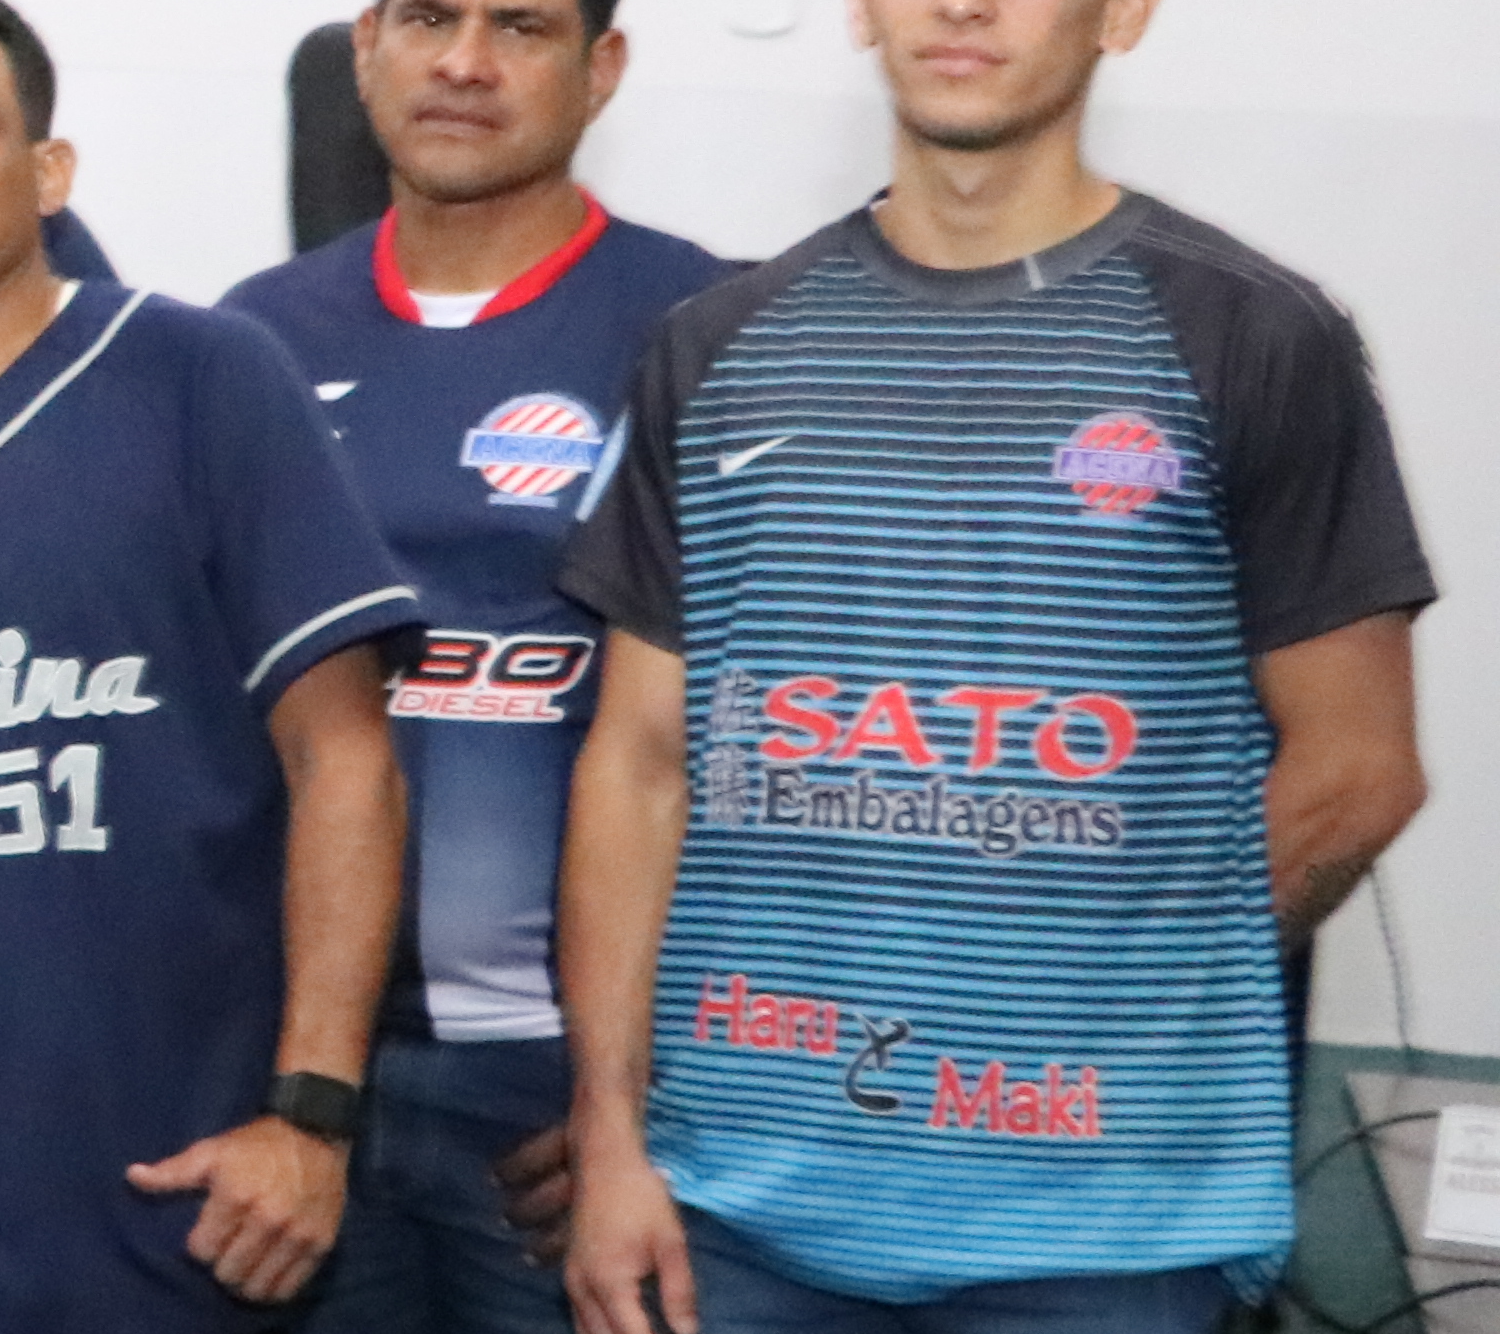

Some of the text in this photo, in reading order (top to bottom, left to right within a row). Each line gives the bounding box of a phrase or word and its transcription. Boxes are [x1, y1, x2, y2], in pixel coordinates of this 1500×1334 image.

[394, 690, 560, 718] DIESEL
[758, 674, 1139, 781] SATO
[762, 768, 1124, 858] Embalagens
[693, 973, 839, 1055] Haru
[928, 1056, 1101, 1138] Maki
